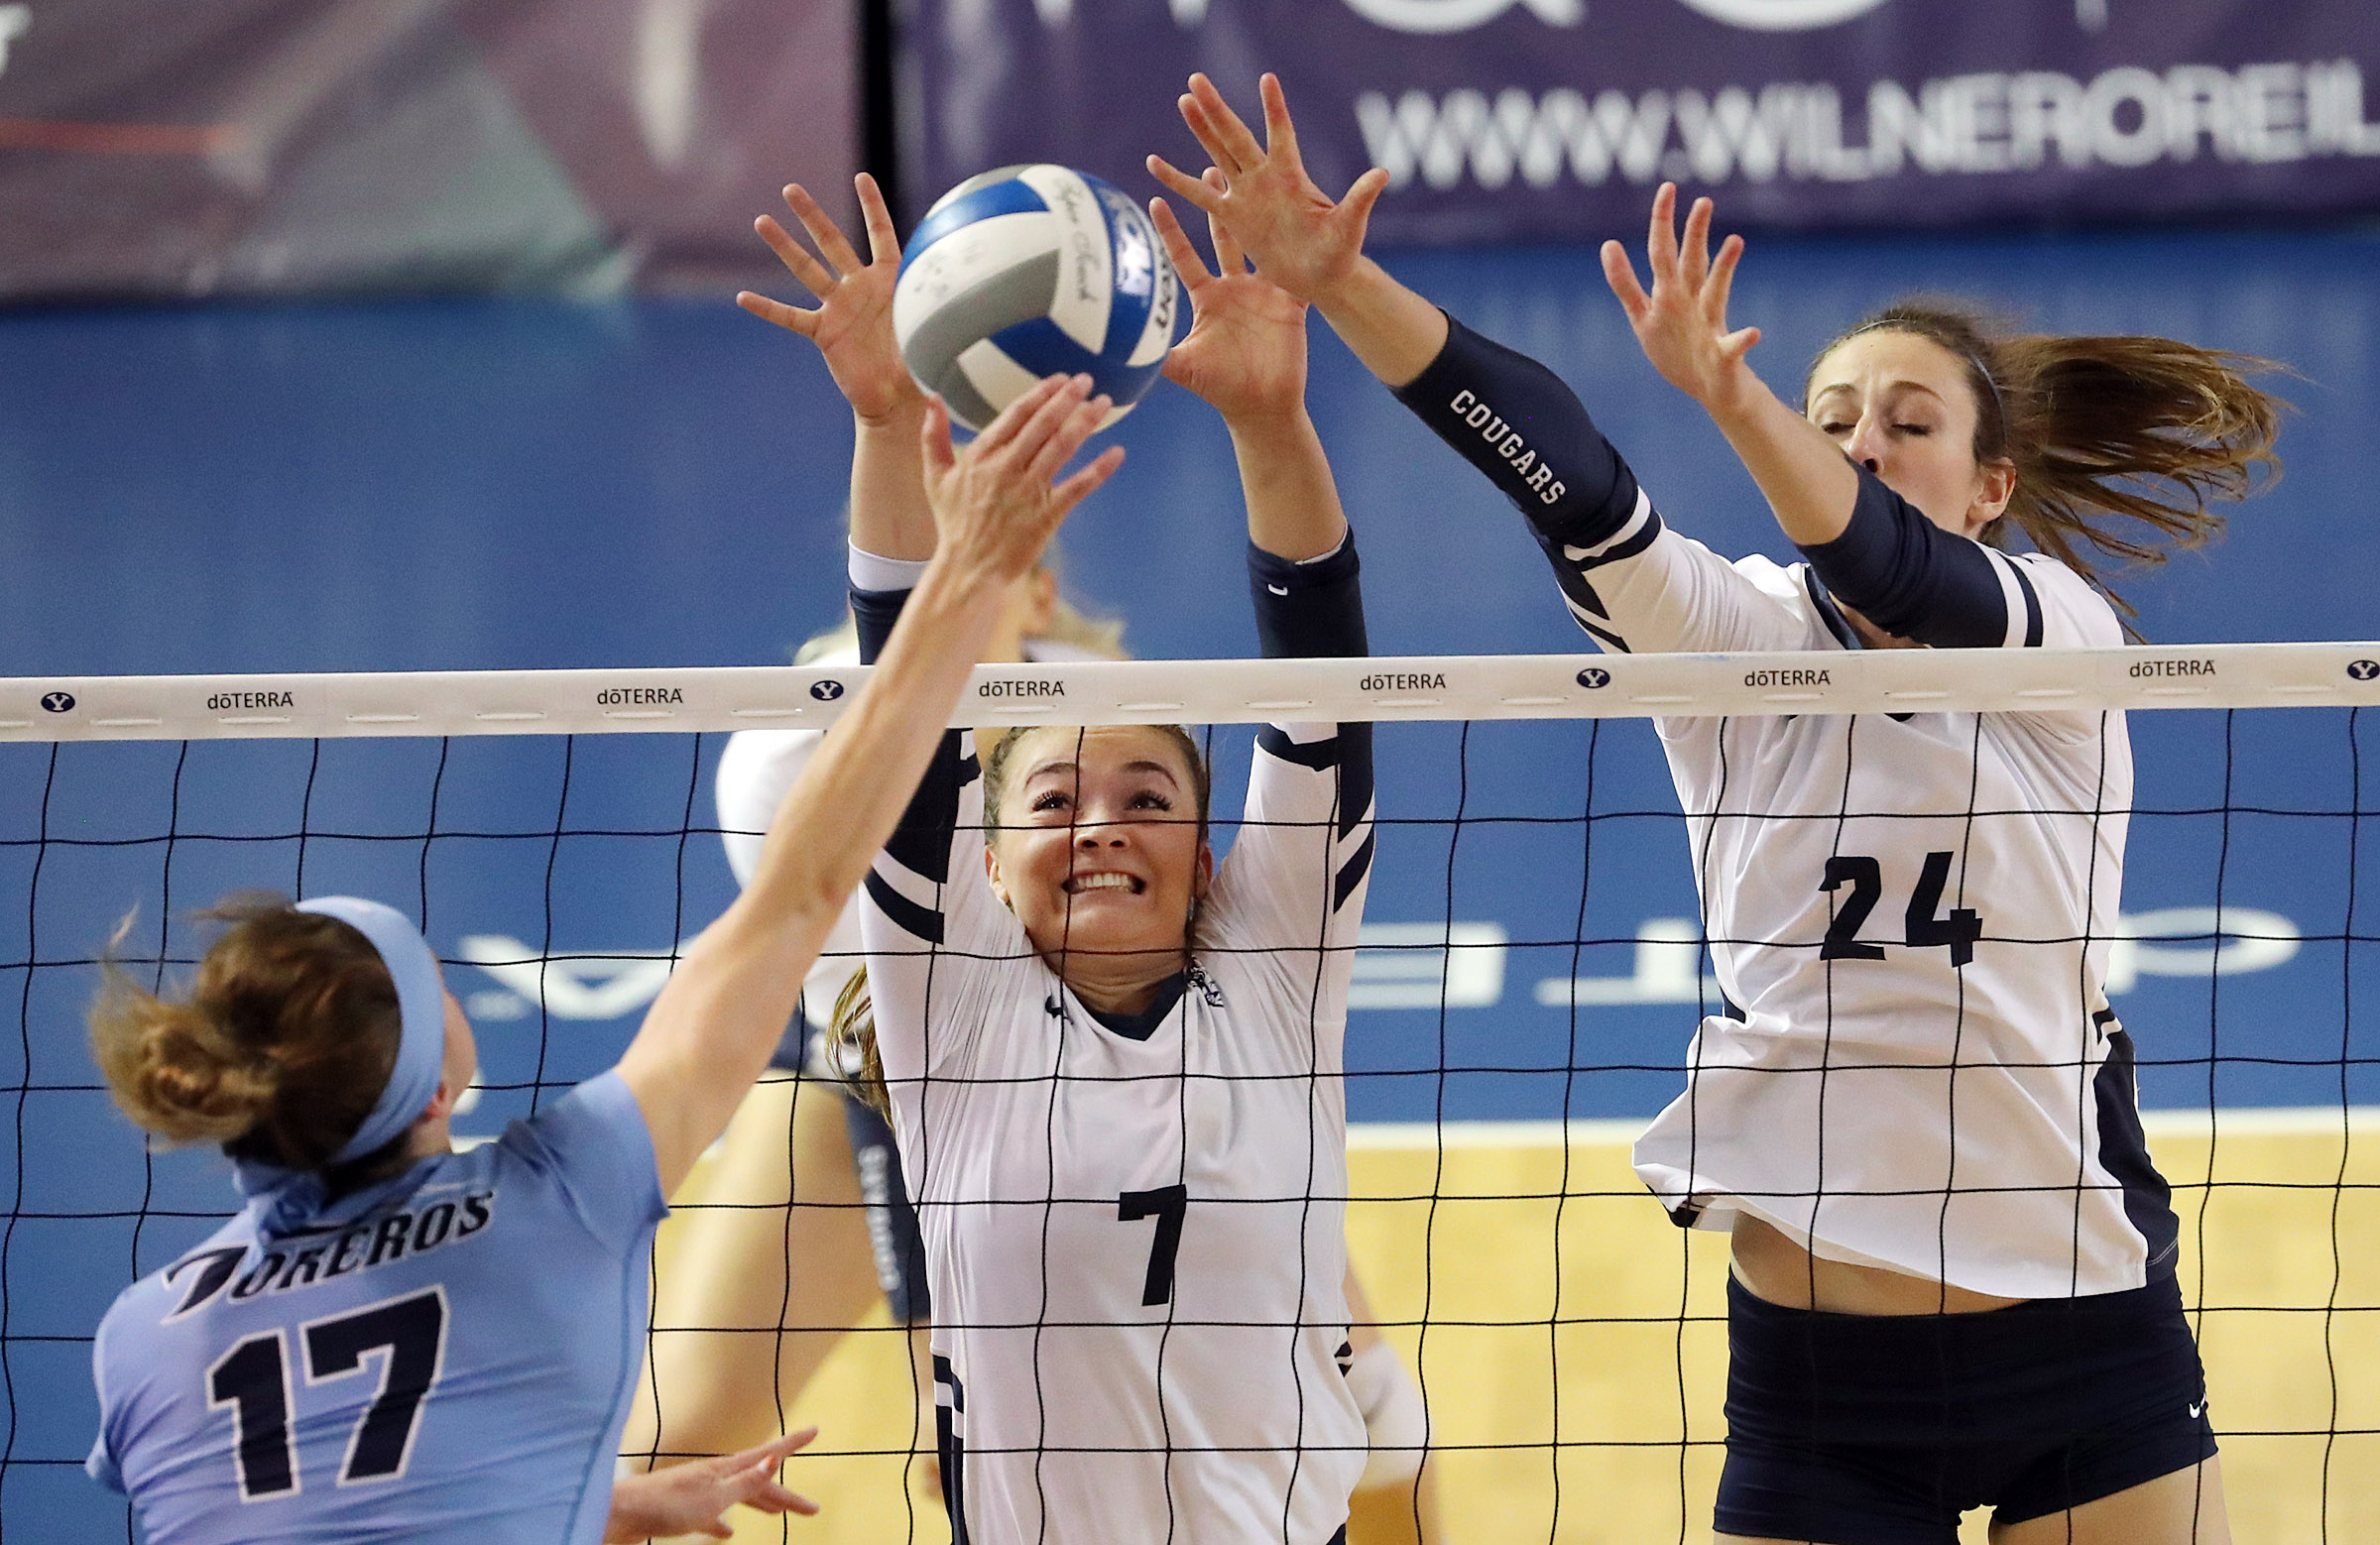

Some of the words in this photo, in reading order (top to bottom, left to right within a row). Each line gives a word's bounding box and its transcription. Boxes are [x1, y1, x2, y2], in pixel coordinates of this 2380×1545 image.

[1449, 389, 1567, 505] COUGARS
[1819, 851, 1982, 967] 24
[1118, 1183, 1187, 1307] 7
[205, 1283, 450, 1503] 17
